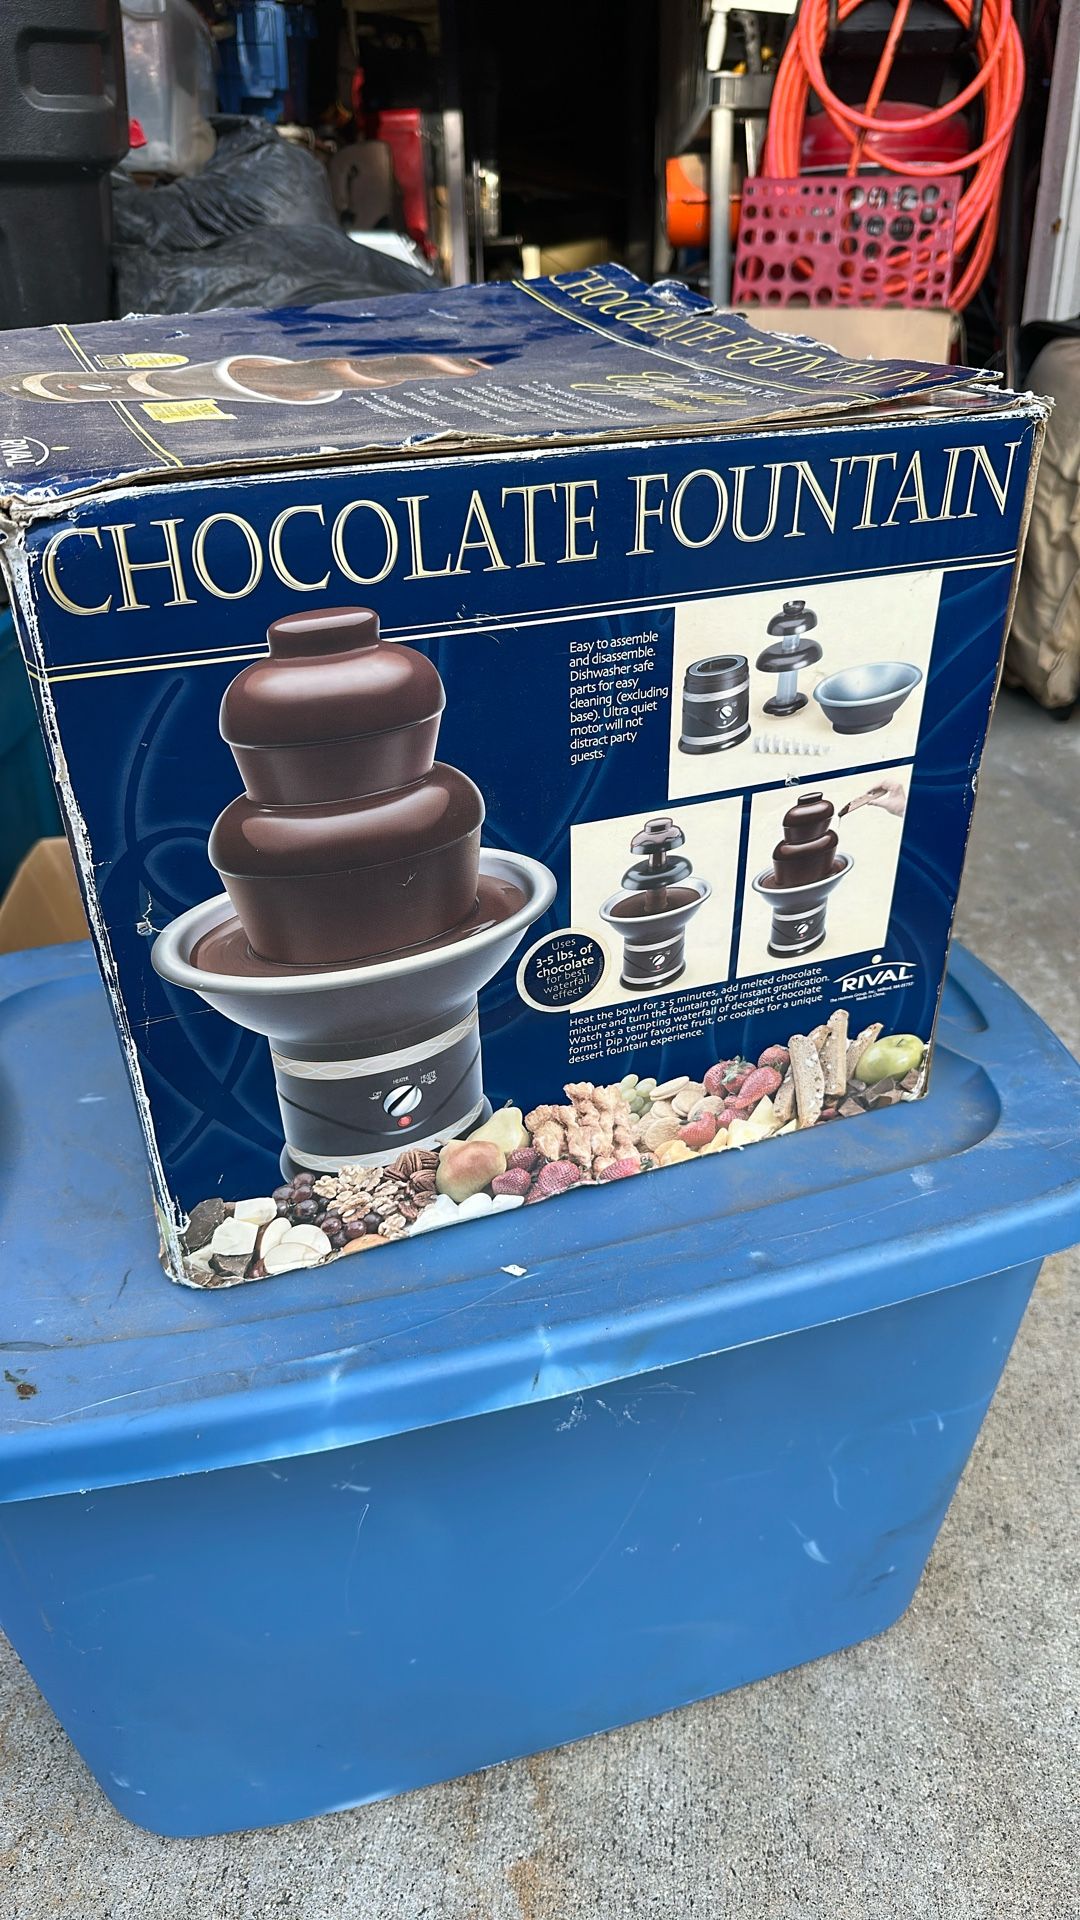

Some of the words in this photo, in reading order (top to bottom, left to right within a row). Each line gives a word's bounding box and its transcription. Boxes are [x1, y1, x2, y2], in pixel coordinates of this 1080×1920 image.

[702, 337, 959, 389] FOUNTAIN
[0, 439, 35, 468] RIVAL
[42, 479, 599, 616] CHOCOLATE
[626, 441, 1022, 556] FOUNTAIN
[570, 641, 594, 653] Easy
[597, 640, 608, 649] to
[610, 631, 658, 648] assemble
[569, 655, 589, 667] and
[592, 646, 656, 664] disassemble.
[570, 664, 631, 681] Dishwasher
[632, 660, 654, 673] safe
[569, 695, 612, 709] cleaning
[617, 687, 669, 704] (excluding
[570, 683, 596, 698] parts
[598, 680, 614, 691] for
[615, 678, 639, 689] easy
[570, 709, 600, 723] base).
[603, 706, 629, 718] Ultra
[631, 701, 658, 716] quiet
[570, 724, 603, 736] motor
[605, 718, 623, 731] will
[625, 717, 643, 728] not
[570, 736, 608, 750] distract
[610, 732, 637, 746] party
[570, 750, 605, 765] guests.
[536, 955, 554, 968] 3-5
[557, 950, 577, 962] lbs.
[580, 942, 593, 955] of
[551, 939, 576, 951] Uses
[536, 957, 594, 978] chocolate
[546, 975, 561, 985] for
[565, 968, 586, 980] best
[543, 975, 590, 994] waterfall
[841, 966, 914, 992] RIVAL
[552, 986, 583, 1000] effect
[570, 1015, 594, 1027] Heat
[597, 1011, 614, 1021] the
[616, 1004, 640, 1016] bowl
[643, 1001, 658, 1011] for
[660, 999, 675, 1009] 3-5
[677, 990, 719, 1004] minutes,
[721, 984, 739, 994] add
[741, 976, 774, 990] melted
[776, 968, 822, 982] chocolate
[569, 1022, 607, 1036] mixture
[609, 1017, 627, 1028] and
[629, 1013, 649, 1023] turn
[651, 1008, 667, 1018] the
[669, 1000, 708, 1015] fountain
[710, 998, 722, 1006] on
[725, 994, 740, 1003] for
[740, 988, 771, 1000] instant
[773, 975, 830, 994] gratification.
[569, 1032, 602, 1045] Watch
[604, 1029, 615, 1038] as
[626, 1017, 671, 1033] tempting
[674, 1006, 717, 1023] waterfall
[719, 1003, 729, 1013] of
[732, 996, 774, 1010] decadent
[776, 986, 822, 1000] chocolate
[569, 1041, 602, 1055] forms!
[606, 1036, 623, 1047] Dip
[625, 1032, 648, 1044] your
[651, 1022, 689, 1036] favorite
[691, 1017, 715, 1028] fruit,
[717, 1014, 728, 1022] or
[730, 1006, 765, 1019] cookies
[767, 1002, 781, 1012] for
[791, 994, 823, 1007] unique
[569, 1051, 604, 1064] dessert
[606, 1041, 648, 1056] fountain
[650, 1028, 705, 1046] experience.
